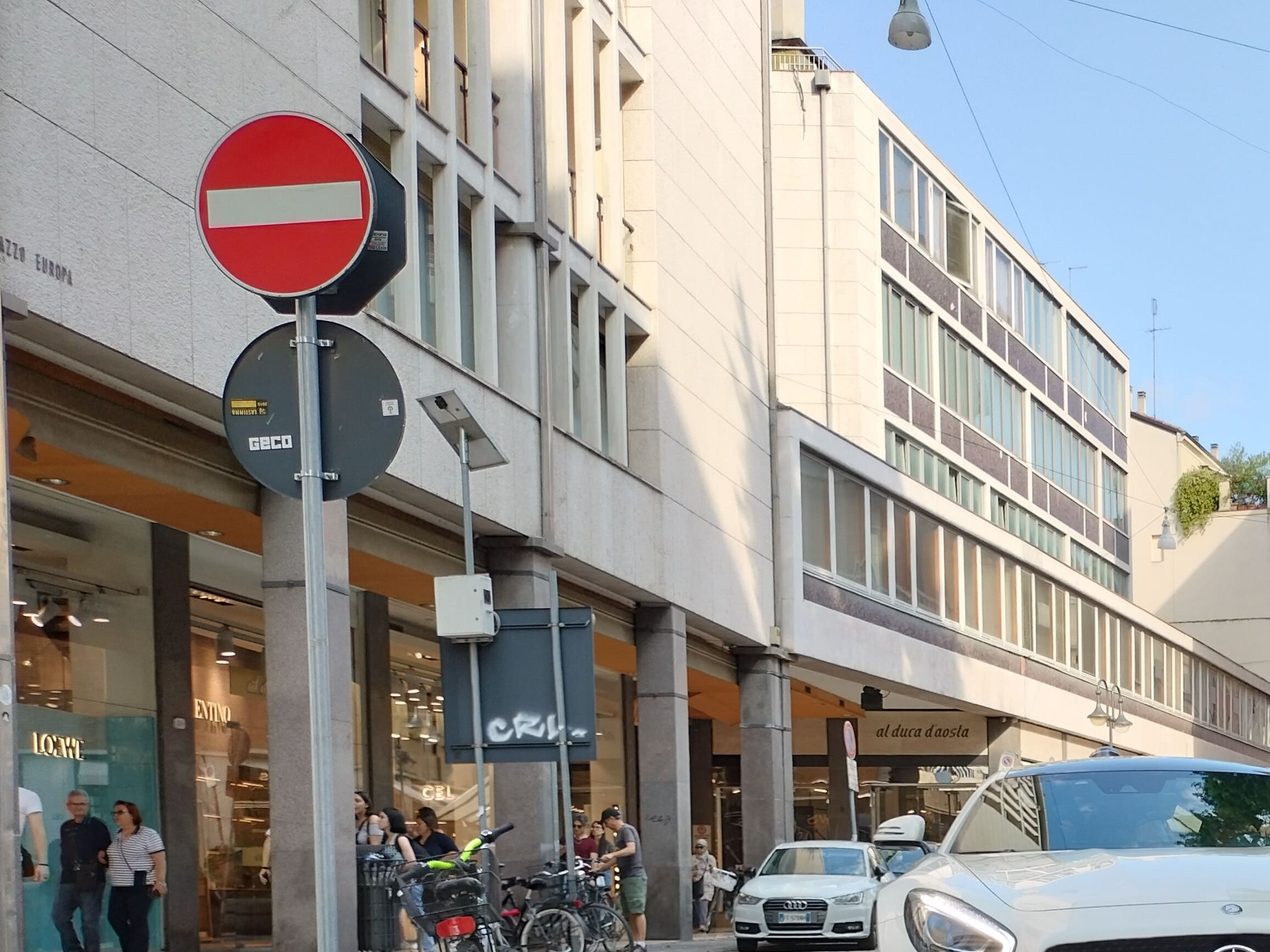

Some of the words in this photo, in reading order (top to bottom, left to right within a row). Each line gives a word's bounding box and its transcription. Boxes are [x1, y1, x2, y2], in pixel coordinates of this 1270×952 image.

[35, 253, 74, 287] EUROPA
[32, 731, 86, 761] LOEWE
[876, 724, 891, 738] al
[891, 724, 922, 738] duca
